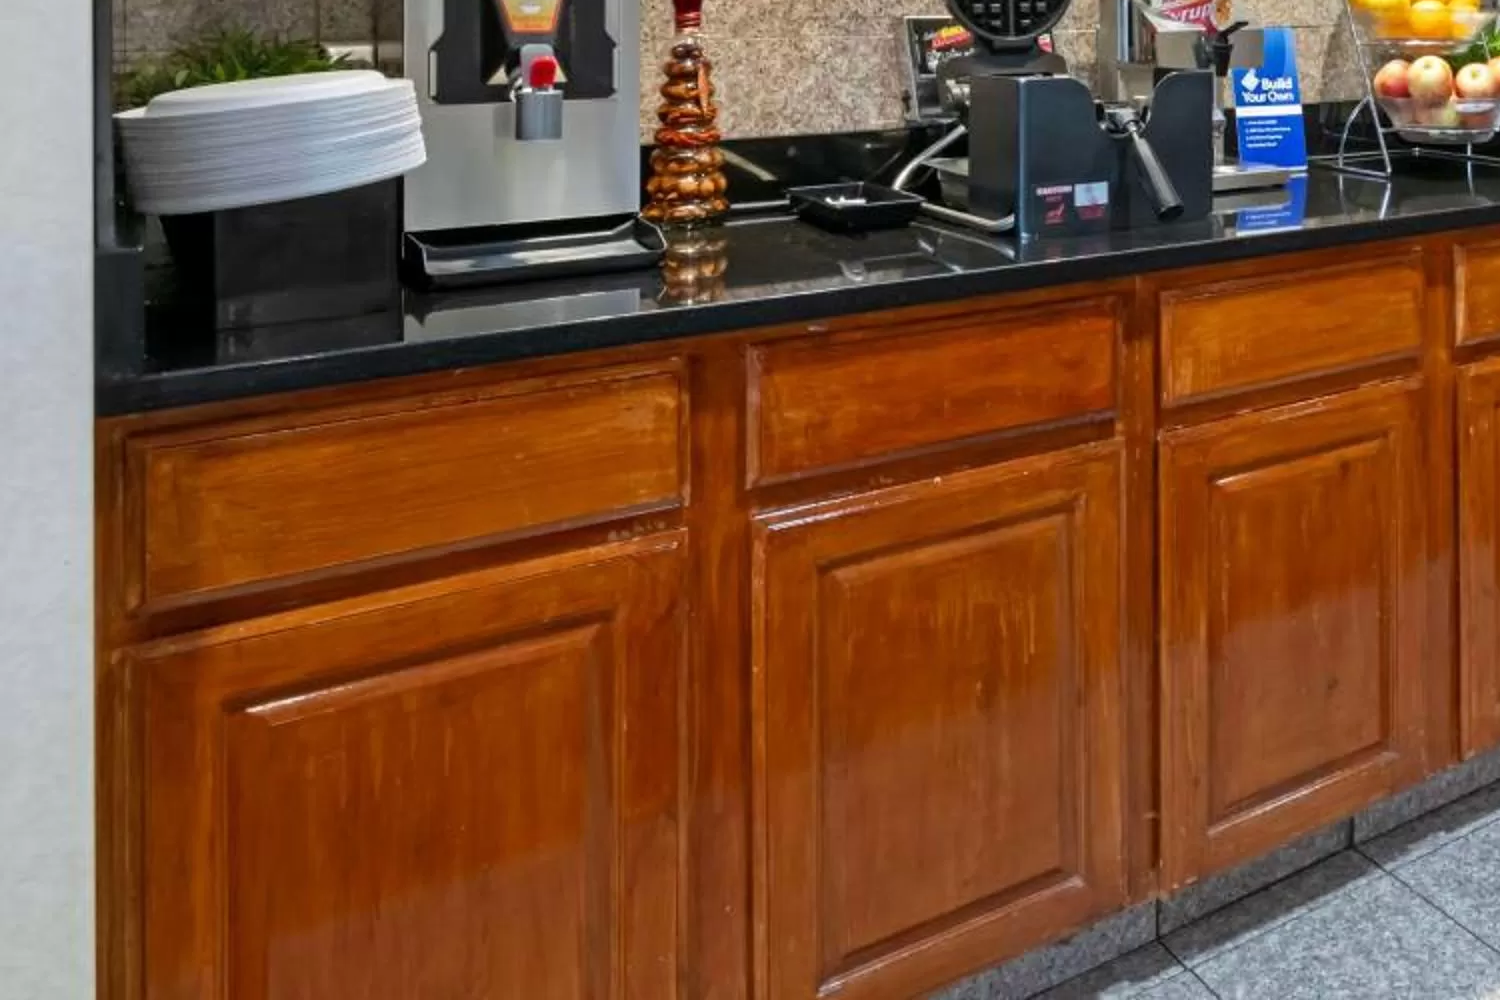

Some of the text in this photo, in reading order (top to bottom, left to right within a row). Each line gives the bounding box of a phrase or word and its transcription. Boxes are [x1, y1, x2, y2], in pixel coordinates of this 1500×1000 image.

[1261, 76, 1293, 91] Build
[1241, 90, 1295, 104] Your Own
